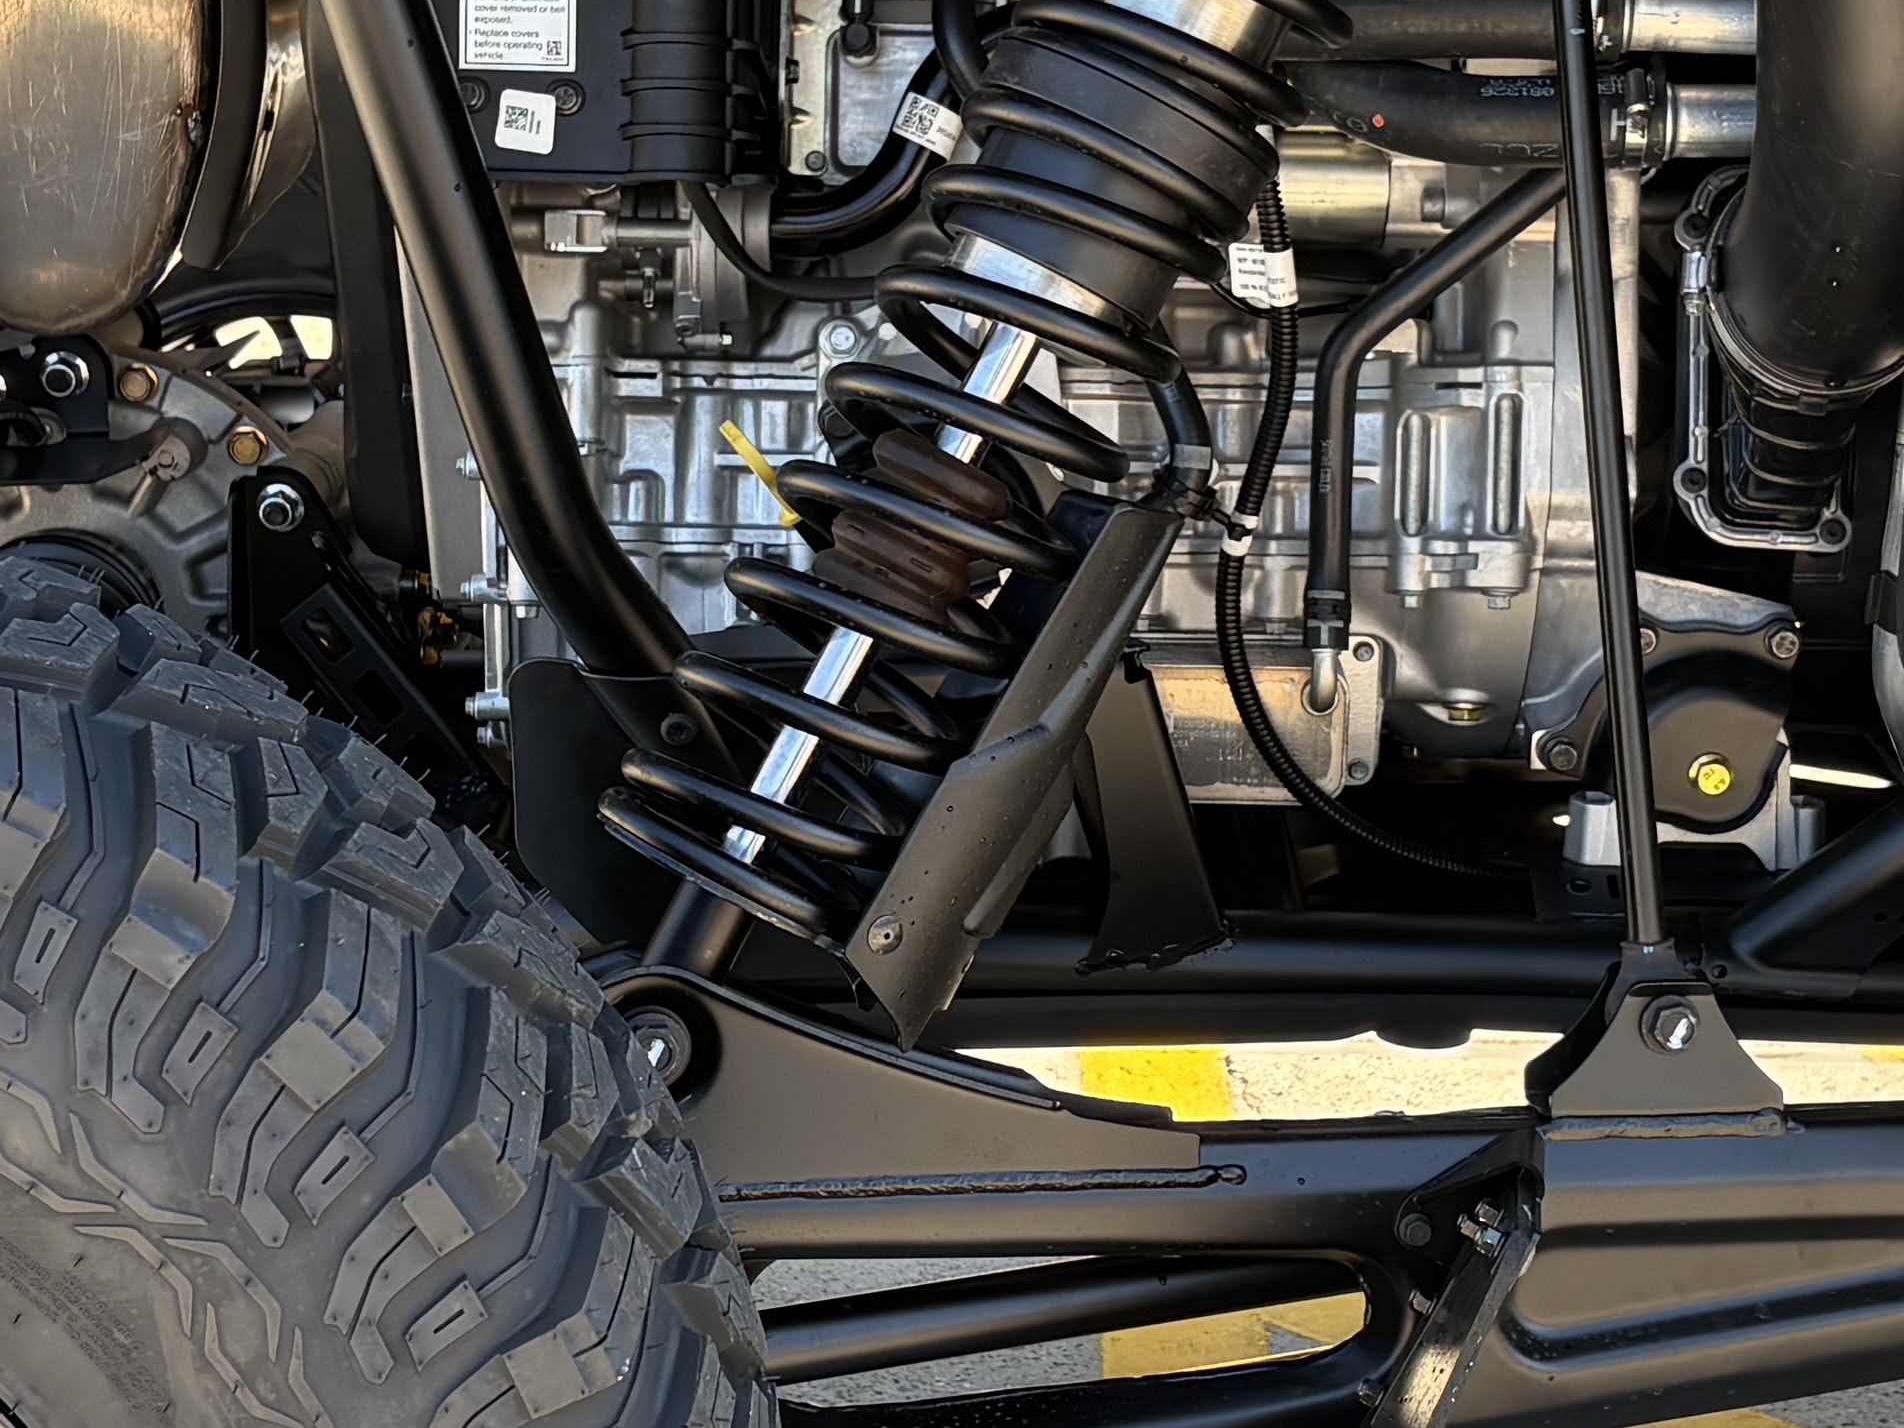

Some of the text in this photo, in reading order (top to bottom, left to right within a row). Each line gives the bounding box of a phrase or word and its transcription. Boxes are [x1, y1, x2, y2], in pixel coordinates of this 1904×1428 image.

[474, 5, 498, 13] cover
[500, 4, 538, 13] removed
[474, 27, 540, 38] Replace covers
[474, 39, 543, 51] before operating
